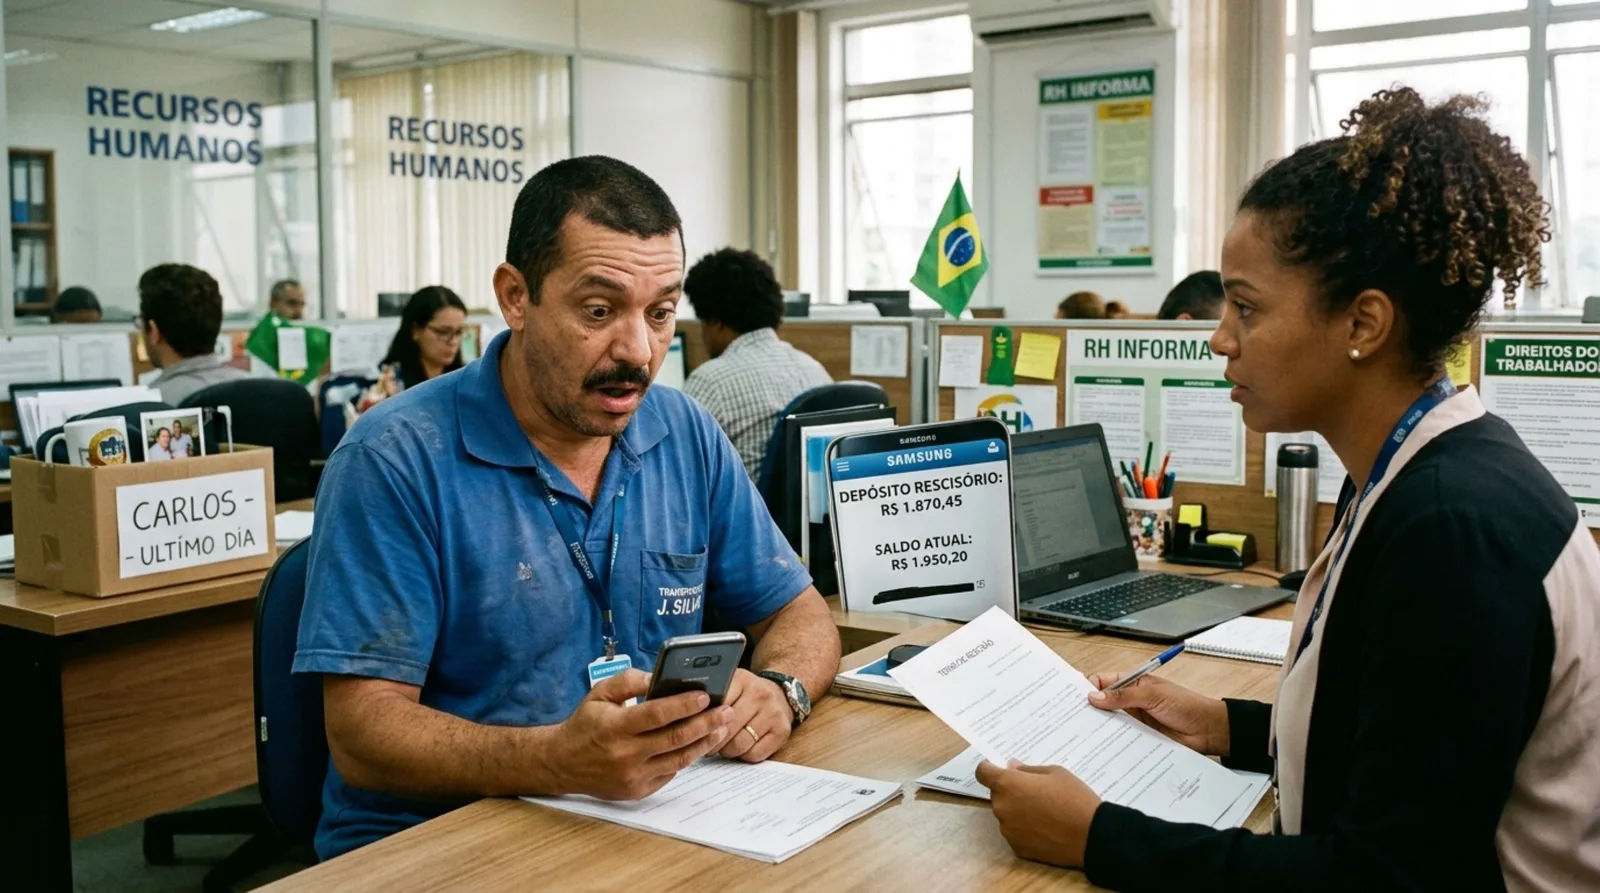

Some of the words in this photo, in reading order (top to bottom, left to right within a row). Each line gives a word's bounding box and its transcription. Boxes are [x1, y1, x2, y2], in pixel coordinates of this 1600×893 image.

[1044, 84, 1067, 101] RH
[1071, 76, 1151, 99] INFORMA
[87, 86, 262, 129] RECURSOS
[389, 116, 524, 151] RECURSOS
[88, 127, 263, 165] HUMANOS
[390, 152, 524, 184] HUMANOS
[1084, 338, 1110, 358] RH
[1117, 339, 1213, 361] INFORMA
[1505, 345, 1572, 357] DIREITOS
[1575, 345, 1599, 358] DO
[1496, 359, 1600, 373] TRABALHADO
[887, 448, 953, 467] SAMSUNG
[839, 483, 911, 503] DEPÓSITO
[914, 471, 1003, 494] RESCISÓRIO:
[132, 490, 237, 531] CARLOS
[881, 503, 899, 517] R$
[903, 494, 963, 514] 1.870,45
[875, 539, 921, 556] SALDO
[924, 533, 973, 550] ATUAL:
[891, 558, 908, 571] R$
[912, 551, 968, 569] 1.950,20
[657, 599, 669, 615] J.
